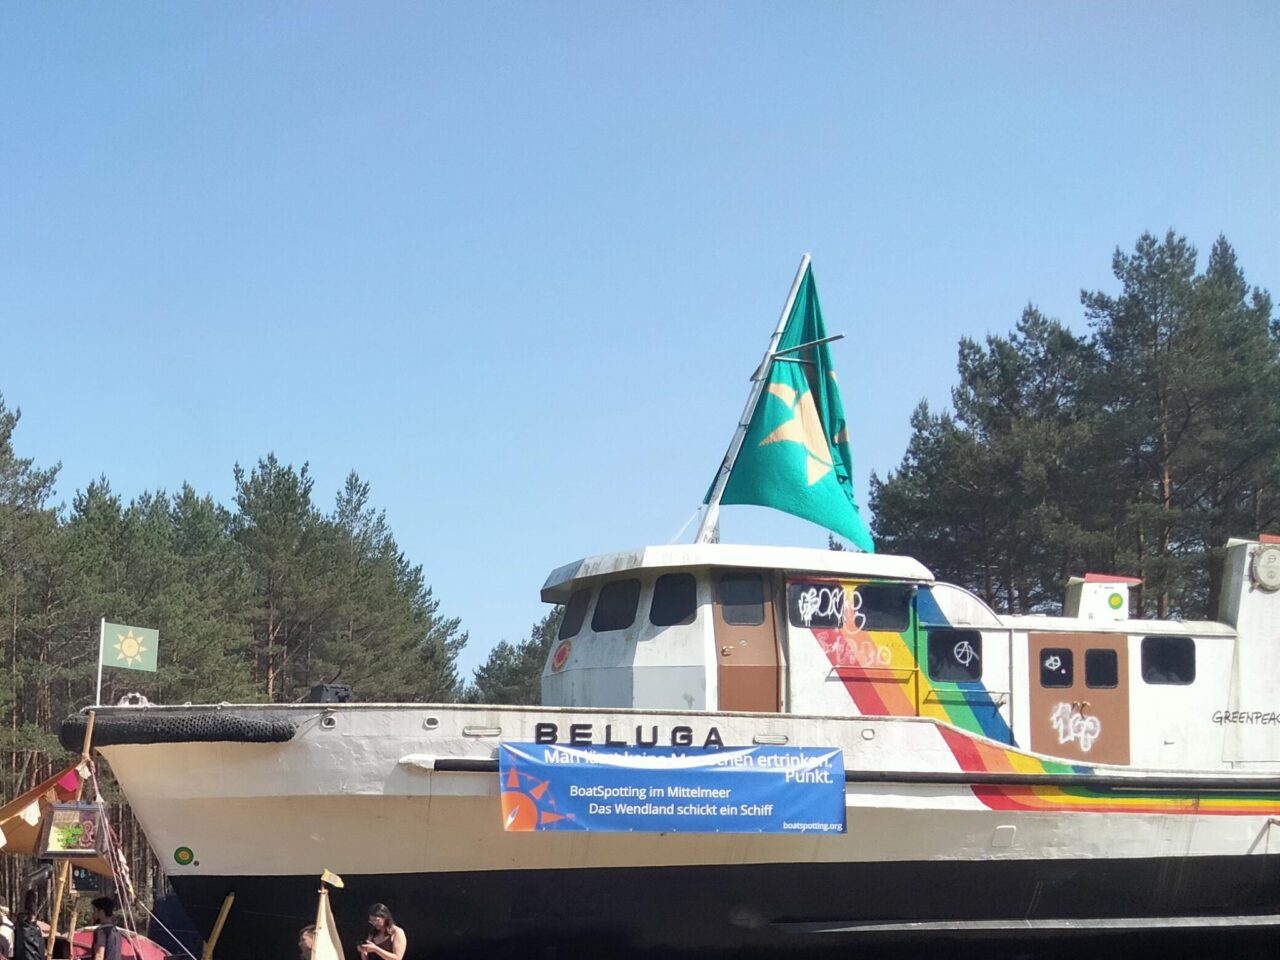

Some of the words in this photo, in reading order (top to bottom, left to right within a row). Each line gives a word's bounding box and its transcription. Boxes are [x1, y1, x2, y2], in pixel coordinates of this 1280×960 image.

[535, 722, 724, 749] BELUGA
[785, 769, 834, 784] Punkt.
[570, 785, 646, 800] BoatSpotting
[649, 786, 664, 797] im
[667, 786, 731, 798] Mittelmeer
[588, 804, 612, 815] Das
[614, 804, 674, 815] Wendland
[677, 804, 717, 816] schickt
[720, 805, 738, 816] ein
[740, 804, 773, 816] Schiff
[783, 822, 842, 831] boatspotting.org
